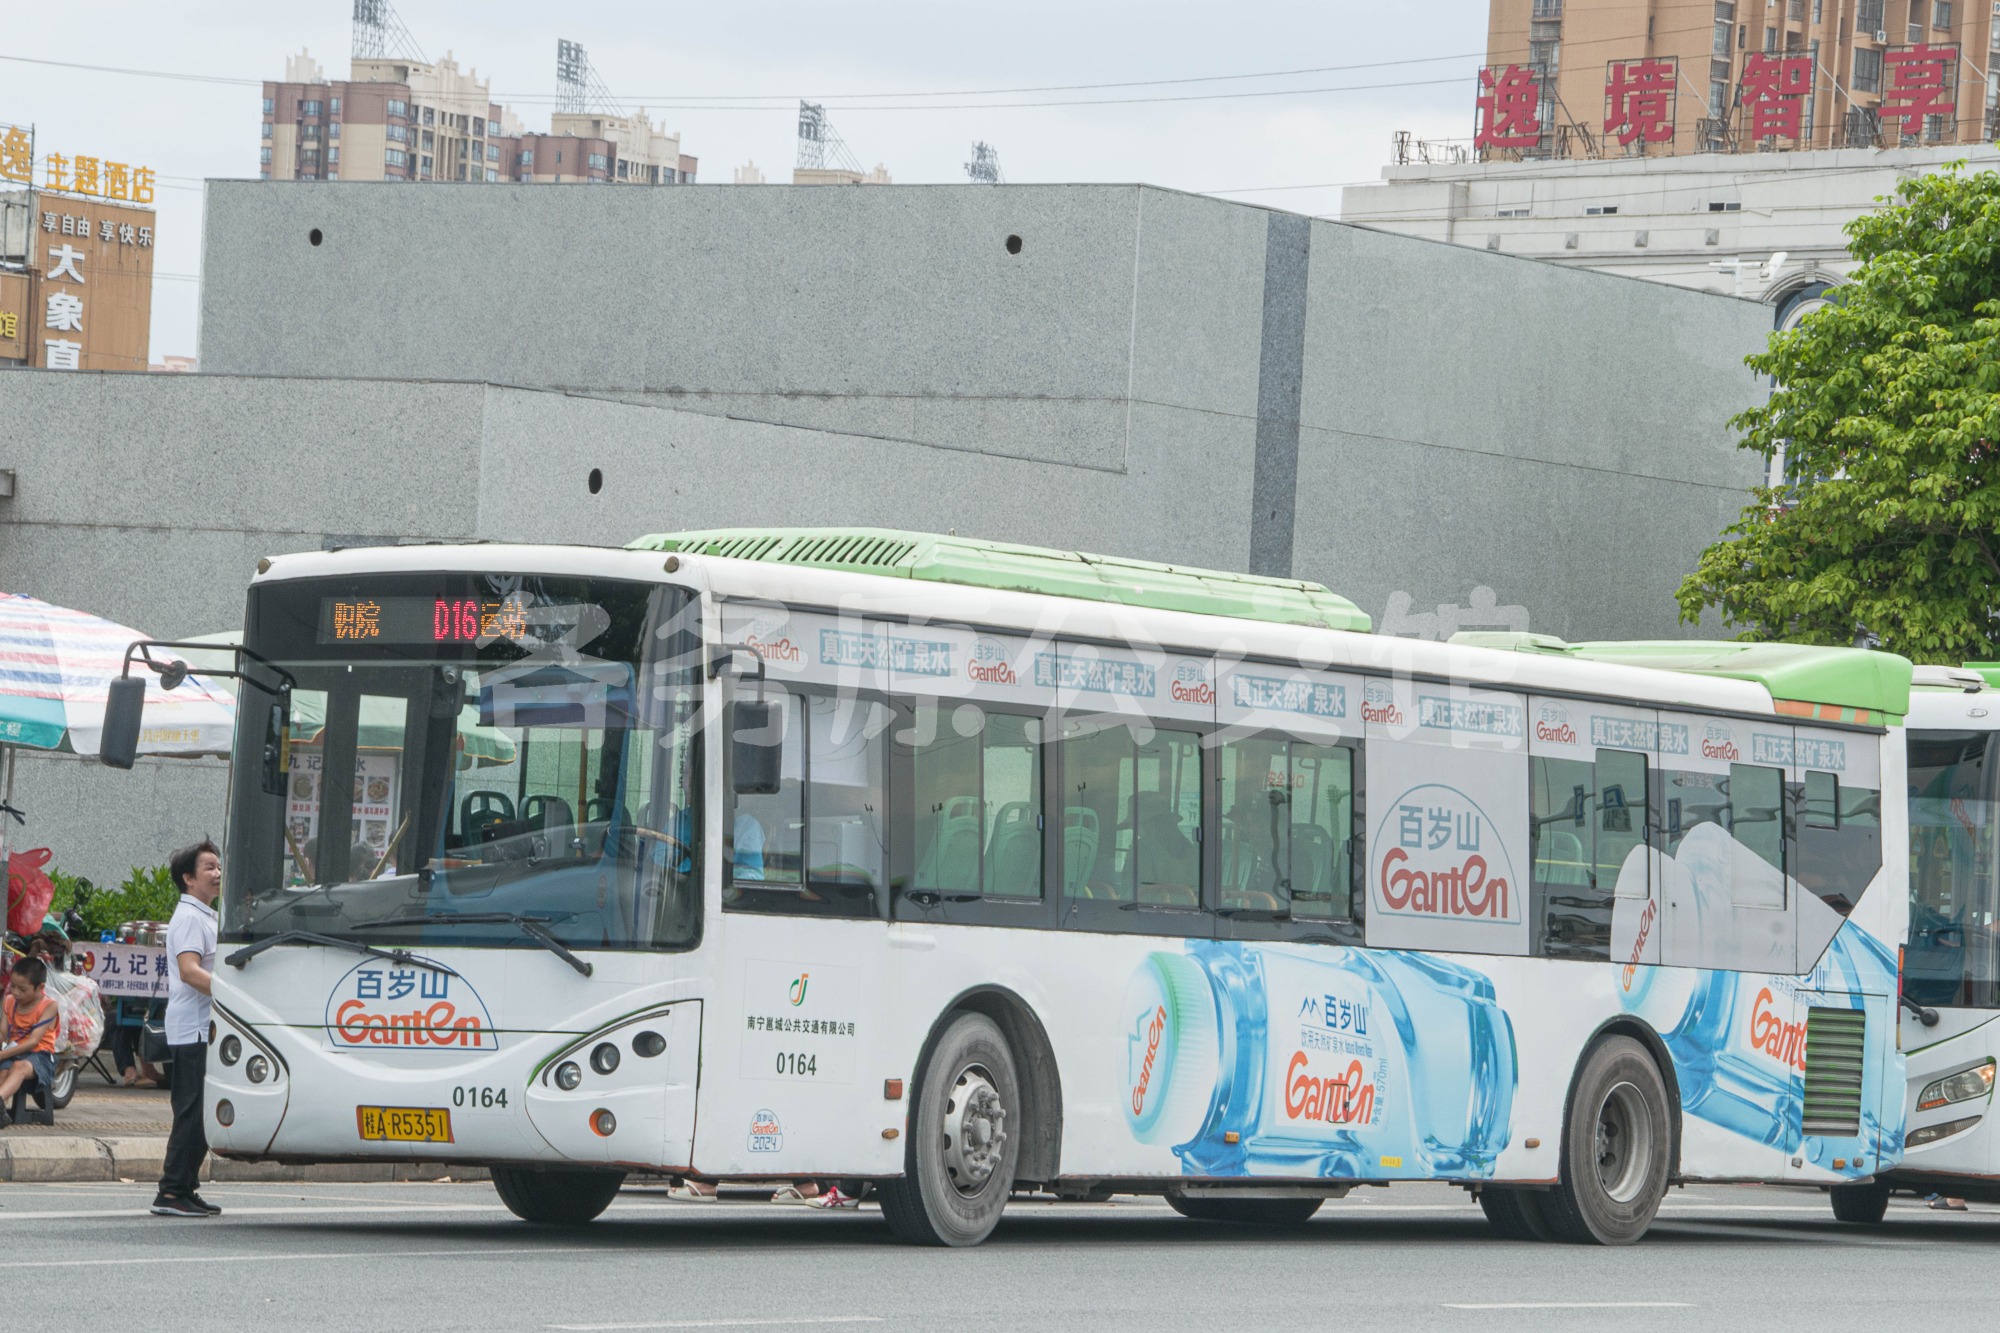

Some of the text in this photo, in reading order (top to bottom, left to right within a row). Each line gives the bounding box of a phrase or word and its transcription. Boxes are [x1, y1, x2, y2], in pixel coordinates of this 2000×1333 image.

[1474, 44, 1956, 150] 逸境智享
[45, 152, 156, 203] 主题酒店
[42, 211, 153, 247] 享自由 享快乐
[434, 601, 478, 640] D16
[822, 631, 950, 675] 真正天然矿泉水
[1036, 653, 1154, 696] 真正天然矿泉水
[1235, 675, 1345, 718] 真正天然矿泉水
[1420, 697, 1521, 736] 真正天然矿泉水
[1592, 717, 1688, 753] 真正天然矿泉水
[1753, 734, 1844, 769] 真正天然矿泉水
[1400, 804, 1480, 852] 百岁山
[1381, 847, 1508, 919] Ganten
[357, 969, 449, 1000] 百岁山
[336, 999, 481, 1047] Ganten
[747, 1015, 855, 1036] 南宁邕城公共交通有限公司
[1324, 994, 1367, 1035] 百岁山
[776, 1052, 817, 1076] 0164
[452, 1086, 508, 1109] 0164
[1285, 1050, 1375, 1125] Ganten
[753, 1136, 777, 1150] 2024
